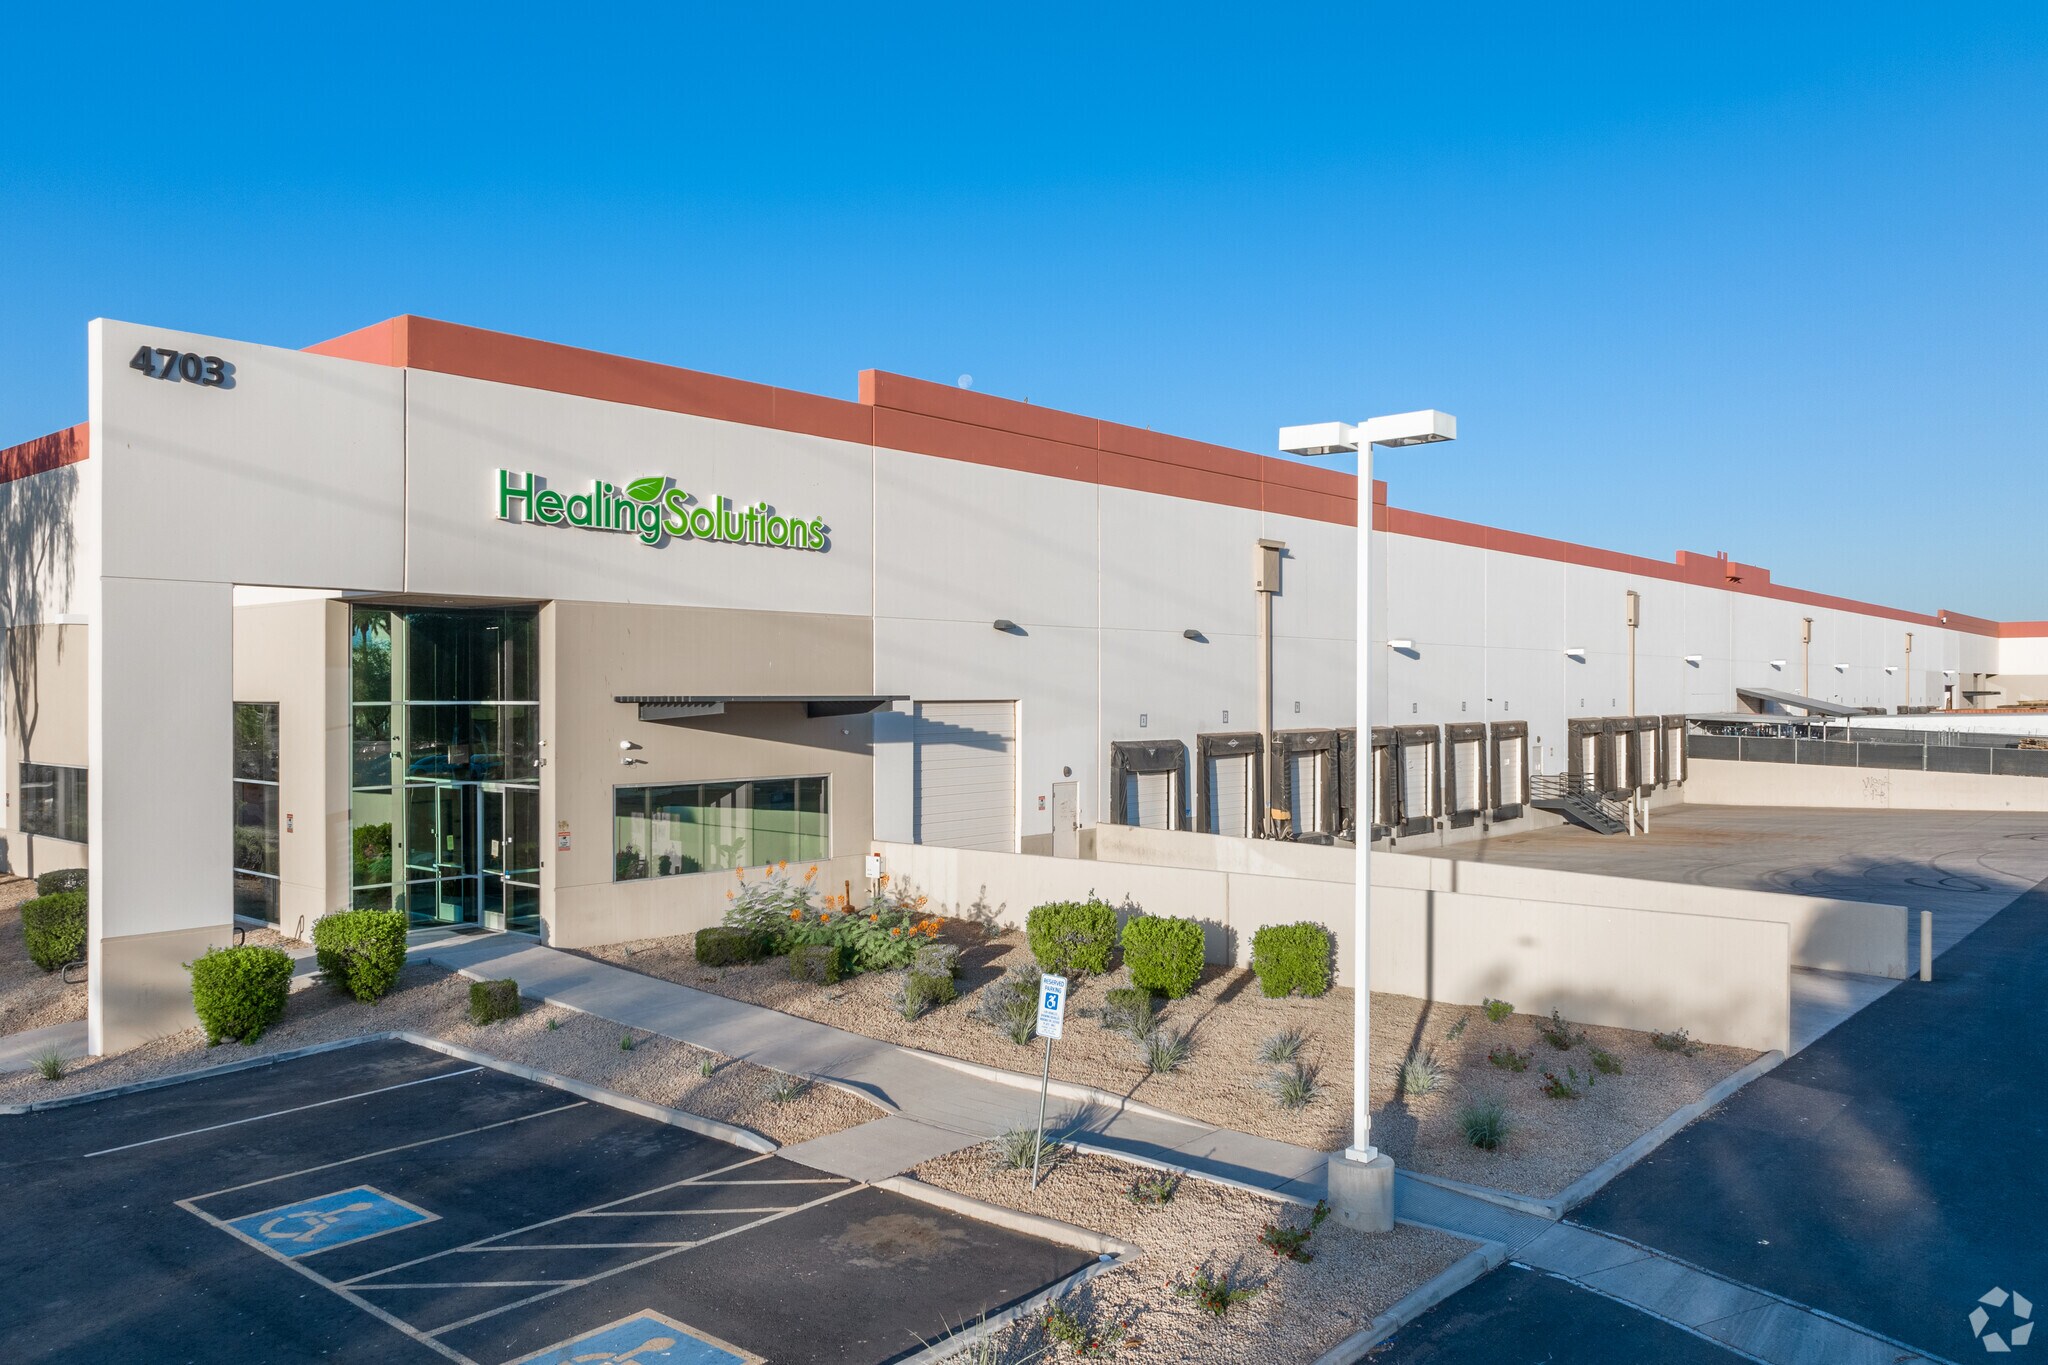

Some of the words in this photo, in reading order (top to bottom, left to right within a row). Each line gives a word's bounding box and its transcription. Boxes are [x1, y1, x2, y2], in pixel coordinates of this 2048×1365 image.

[129, 345, 225, 385] 4703
[1043, 978, 1065, 987] RESERVED
[1045, 985, 1062, 994] PARKING
